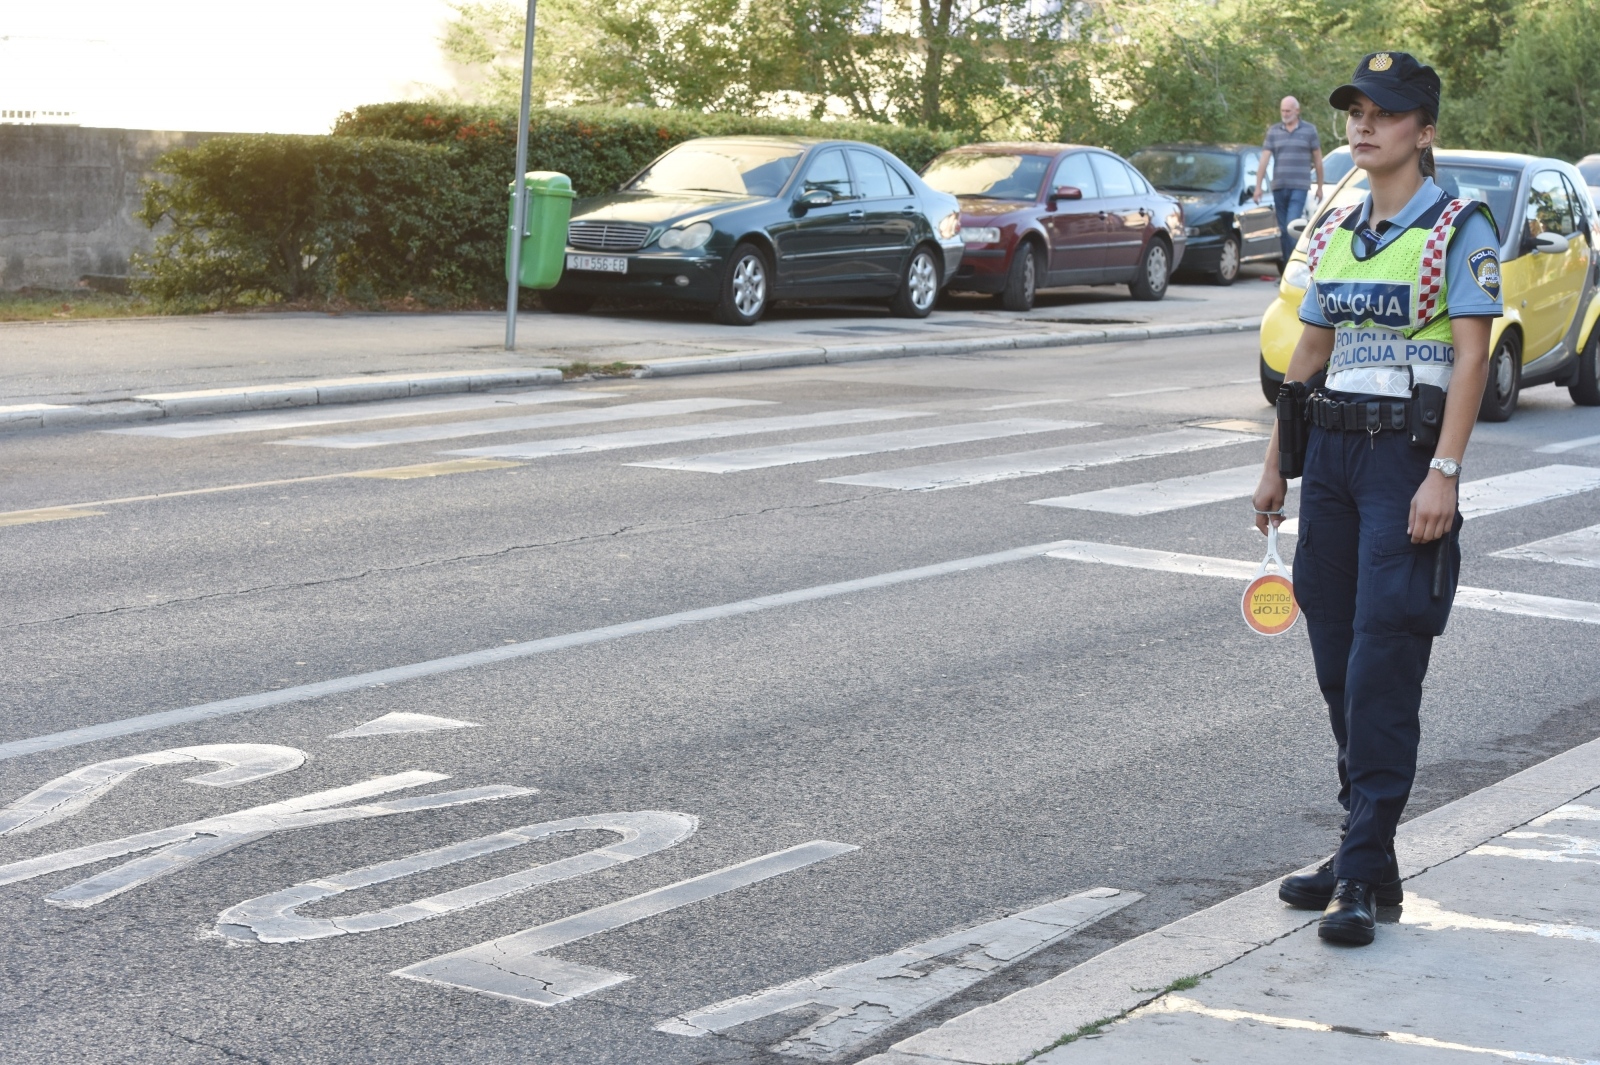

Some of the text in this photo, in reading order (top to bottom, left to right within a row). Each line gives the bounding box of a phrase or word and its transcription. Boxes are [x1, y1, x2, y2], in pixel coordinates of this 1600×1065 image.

[1319, 293, 1403, 316] POLICIJA
[1333, 345, 1396, 368] POLICIJA
[1253, 594, 1290, 602] POLICIJA
[1253, 606, 1290, 615] STOP
